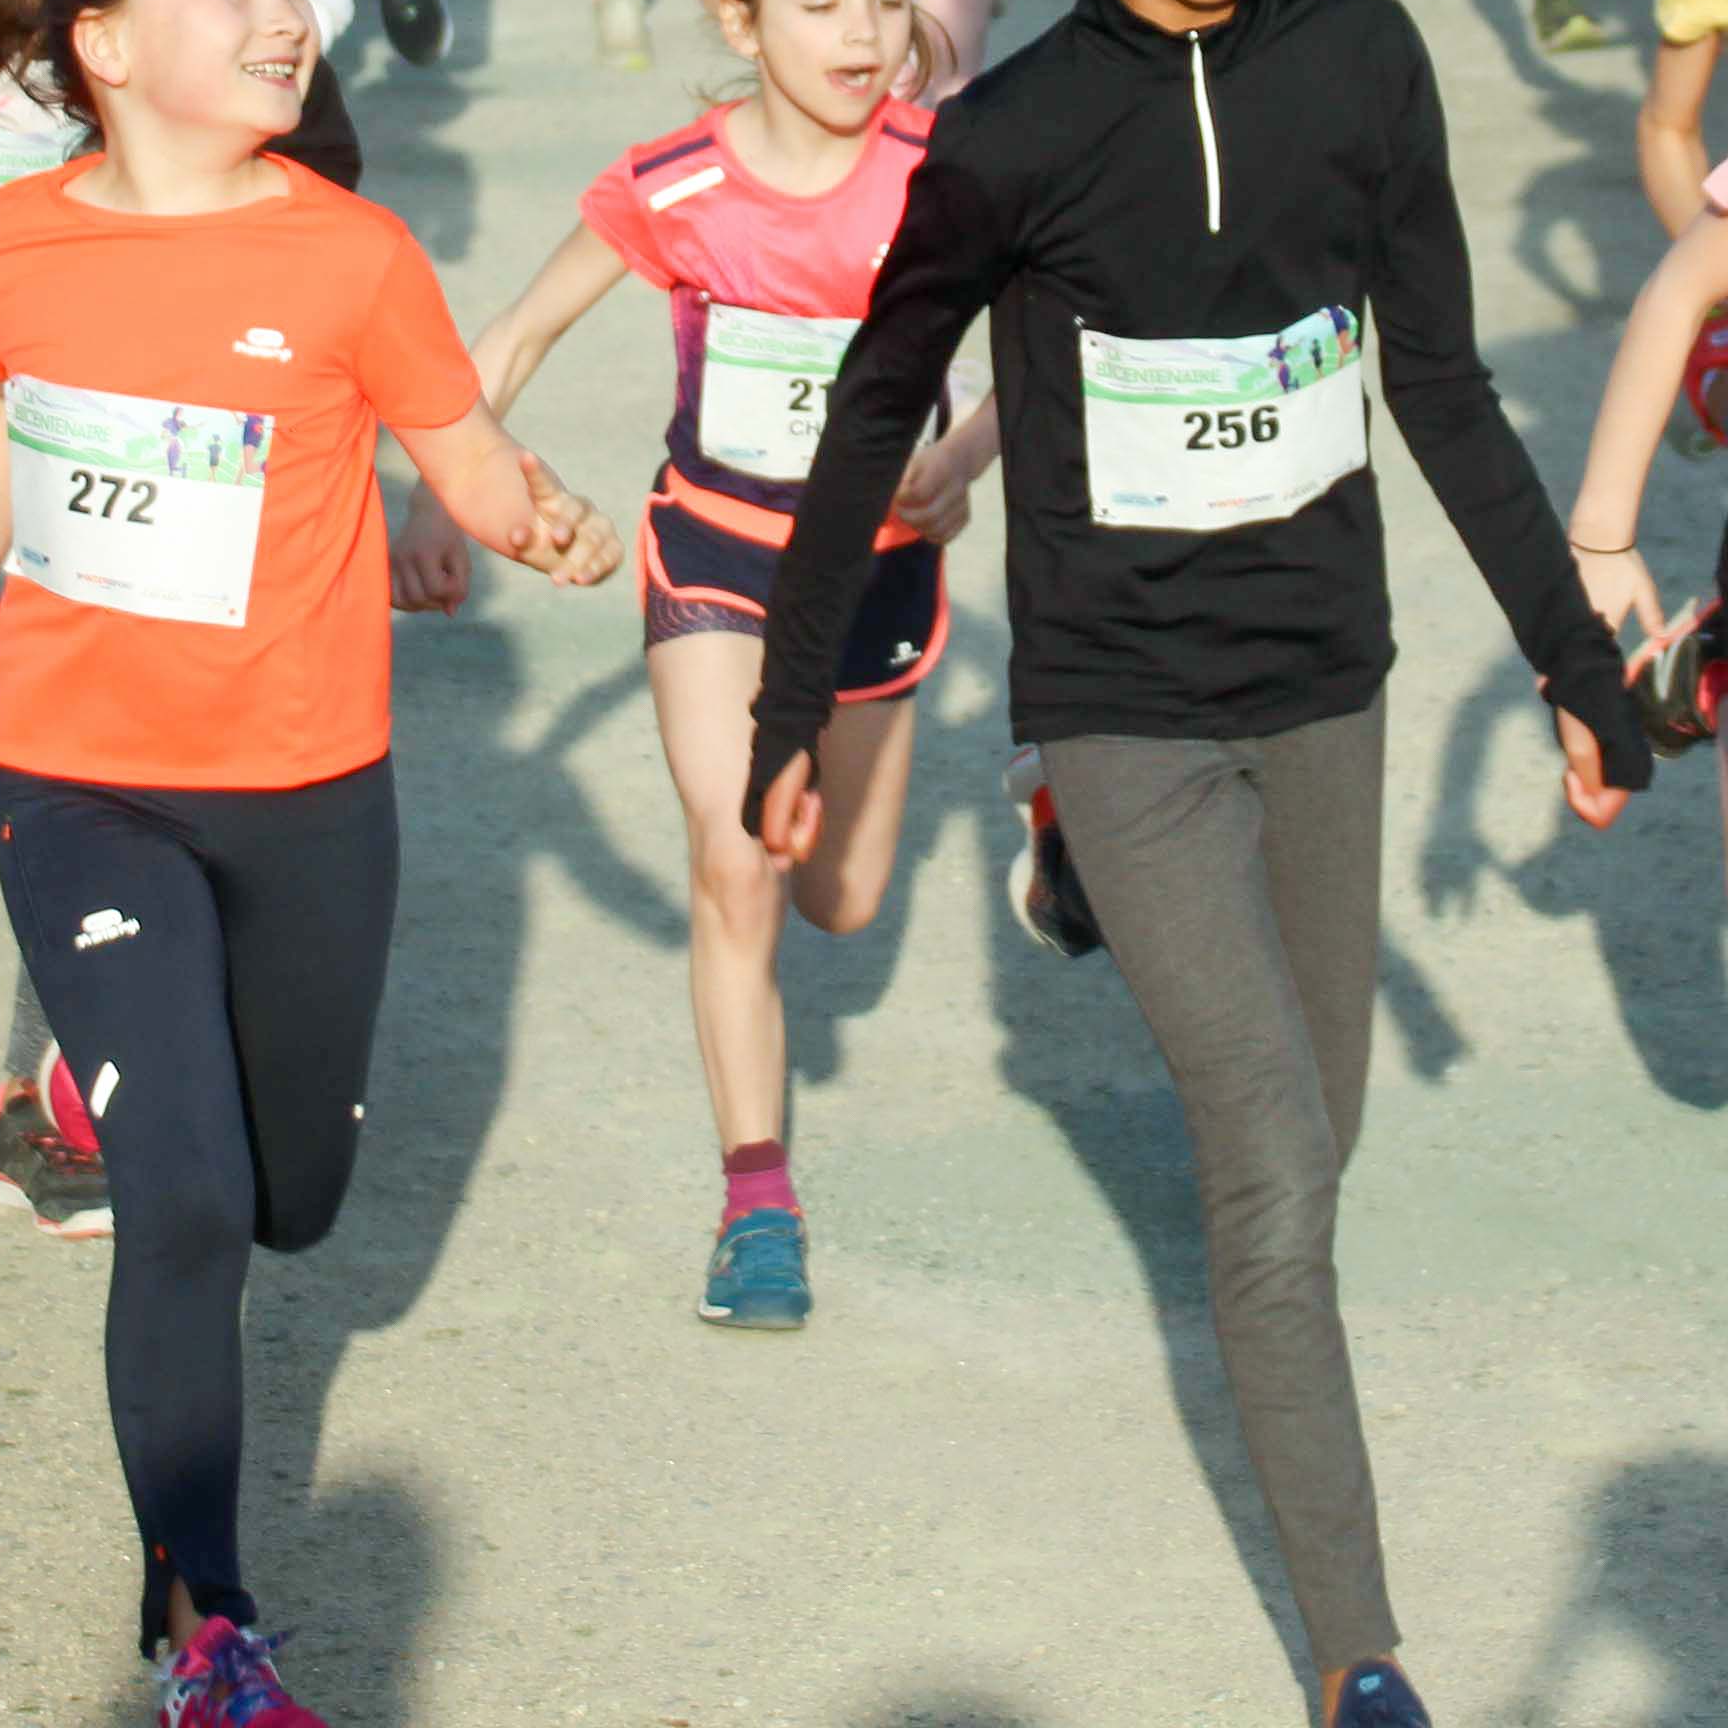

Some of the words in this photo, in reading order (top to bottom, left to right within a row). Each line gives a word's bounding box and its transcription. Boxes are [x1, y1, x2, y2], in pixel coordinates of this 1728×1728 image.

[1095, 361, 1223, 384] BICENTENAIRE
[14, 405, 112, 443] BICENTENAIRE
[790, 420, 822, 436] CH
[1183, 405, 1280, 451] 256
[68, 468, 159, 525] 272
